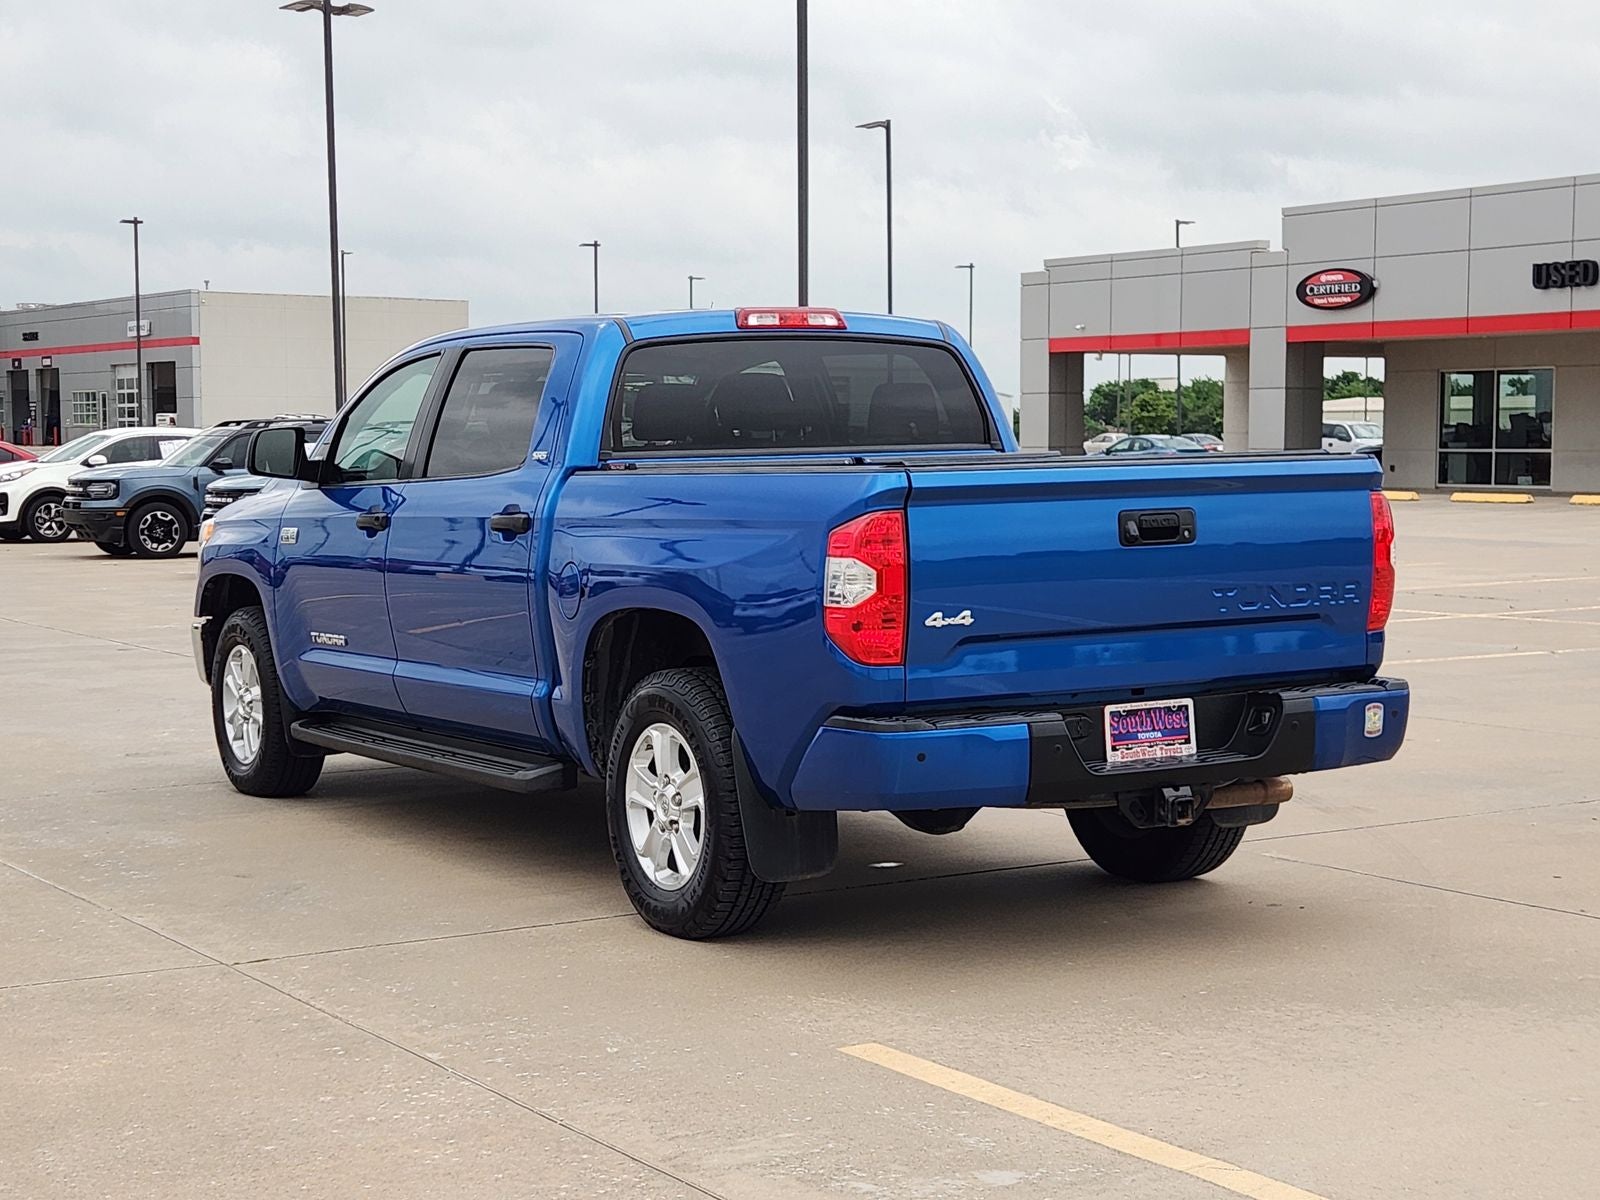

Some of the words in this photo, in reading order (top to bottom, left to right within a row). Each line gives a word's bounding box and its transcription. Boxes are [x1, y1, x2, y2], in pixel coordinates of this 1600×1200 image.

[1532, 260, 1599, 289] USED
[1306, 283, 1361, 296] CERTIFIED
[1211, 581, 1361, 613] TUNDRA
[310, 631, 347, 647] TUNDRA
[1111, 708, 1188, 734] SouthWest
[1137, 731, 1163, 740] TOYOTA
